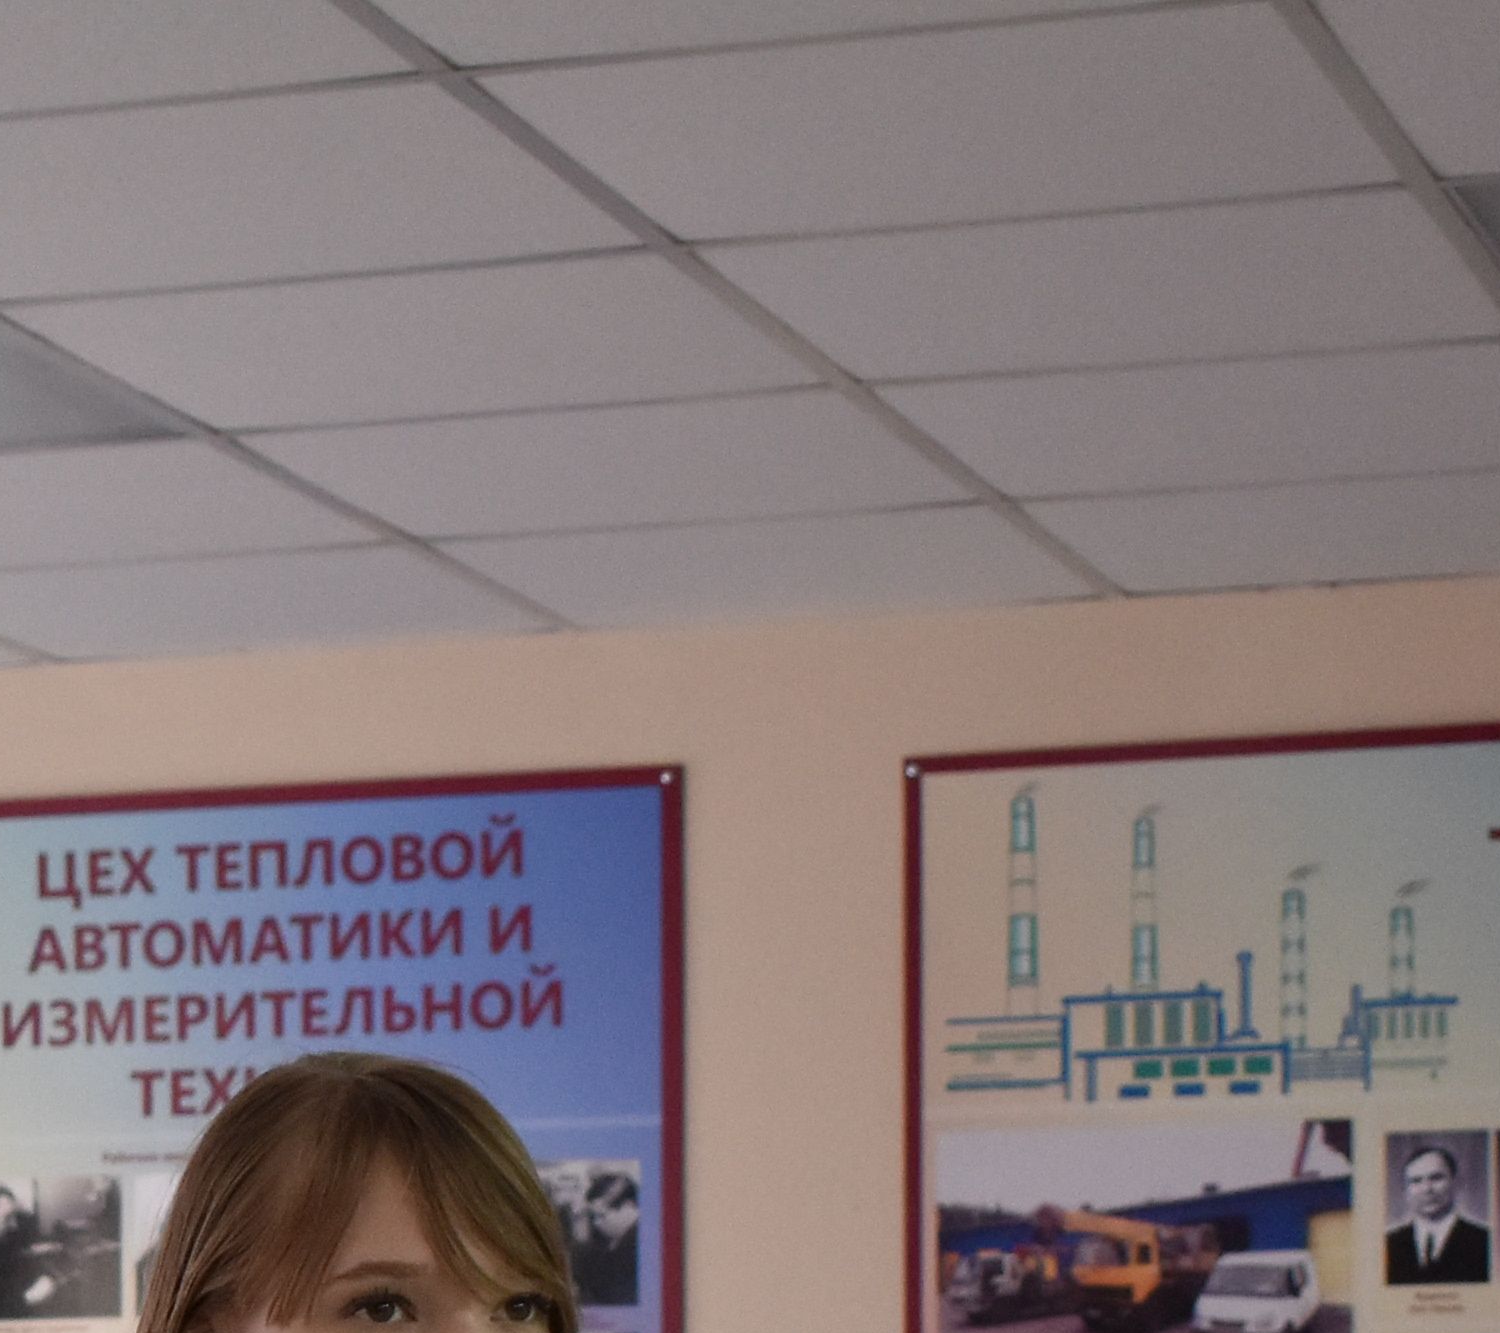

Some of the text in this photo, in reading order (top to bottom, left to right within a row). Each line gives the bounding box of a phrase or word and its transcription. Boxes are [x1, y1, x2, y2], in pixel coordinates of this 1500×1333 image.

[36, 814, 525, 909] ЦЕХ ТЕПЛОВОЙ
[28, 903, 535, 974] АВТОМАТИКИ И
[1, 963, 564, 1048] ИЗМЕРИТЕЛЬНОЙ
[131, 1066, 258, 1117] ТЕХ
